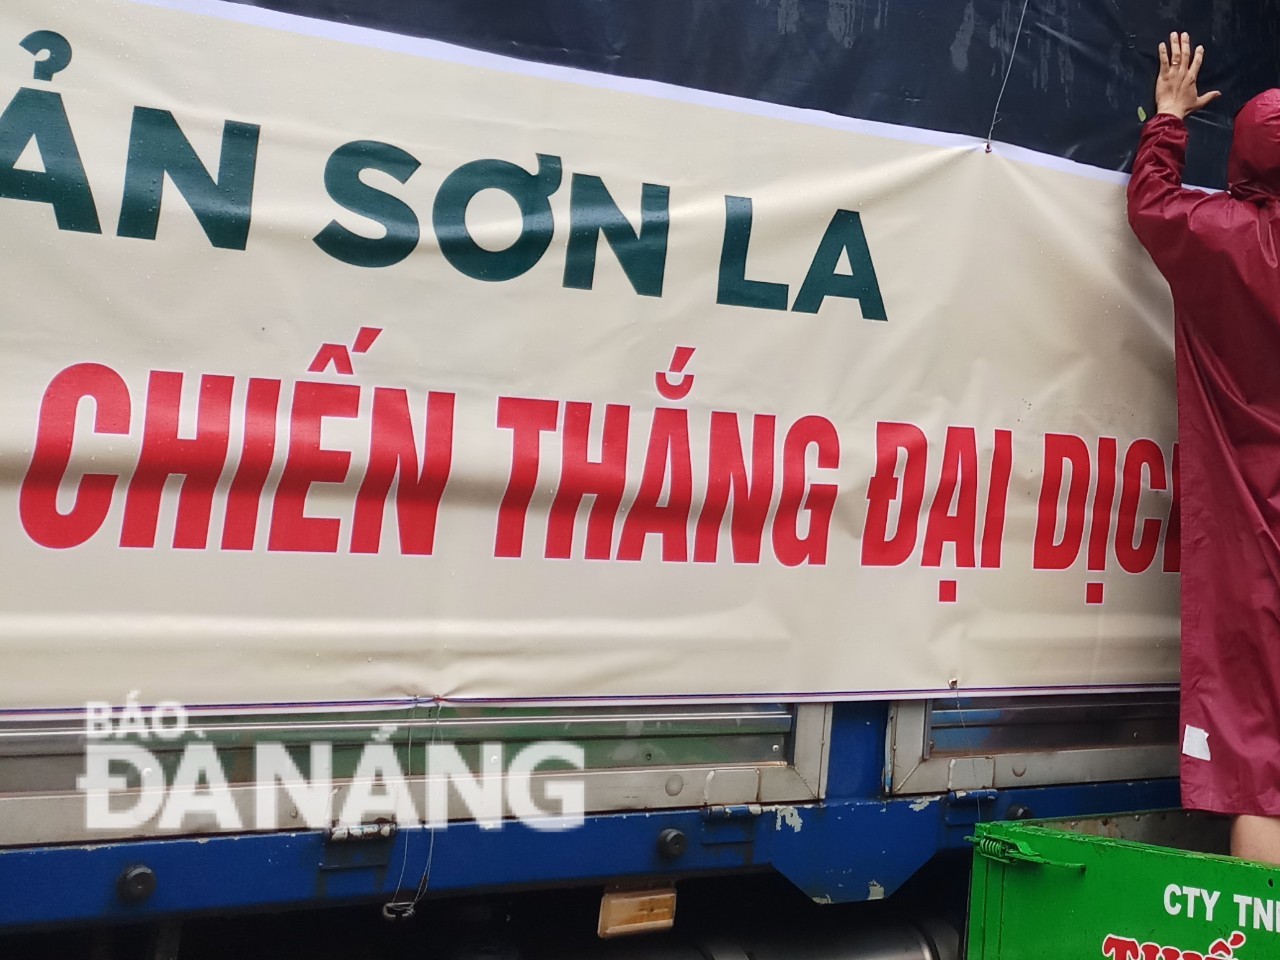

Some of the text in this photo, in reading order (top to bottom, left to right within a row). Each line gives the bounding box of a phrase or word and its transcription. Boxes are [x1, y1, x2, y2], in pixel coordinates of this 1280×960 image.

[0, 30, 888, 322] ẢN SƠN LA
[18, 327, 1181, 606] CHIẾN THẮNG ĐẠI DỊC
[1163, 883, 1221, 921] CTY
